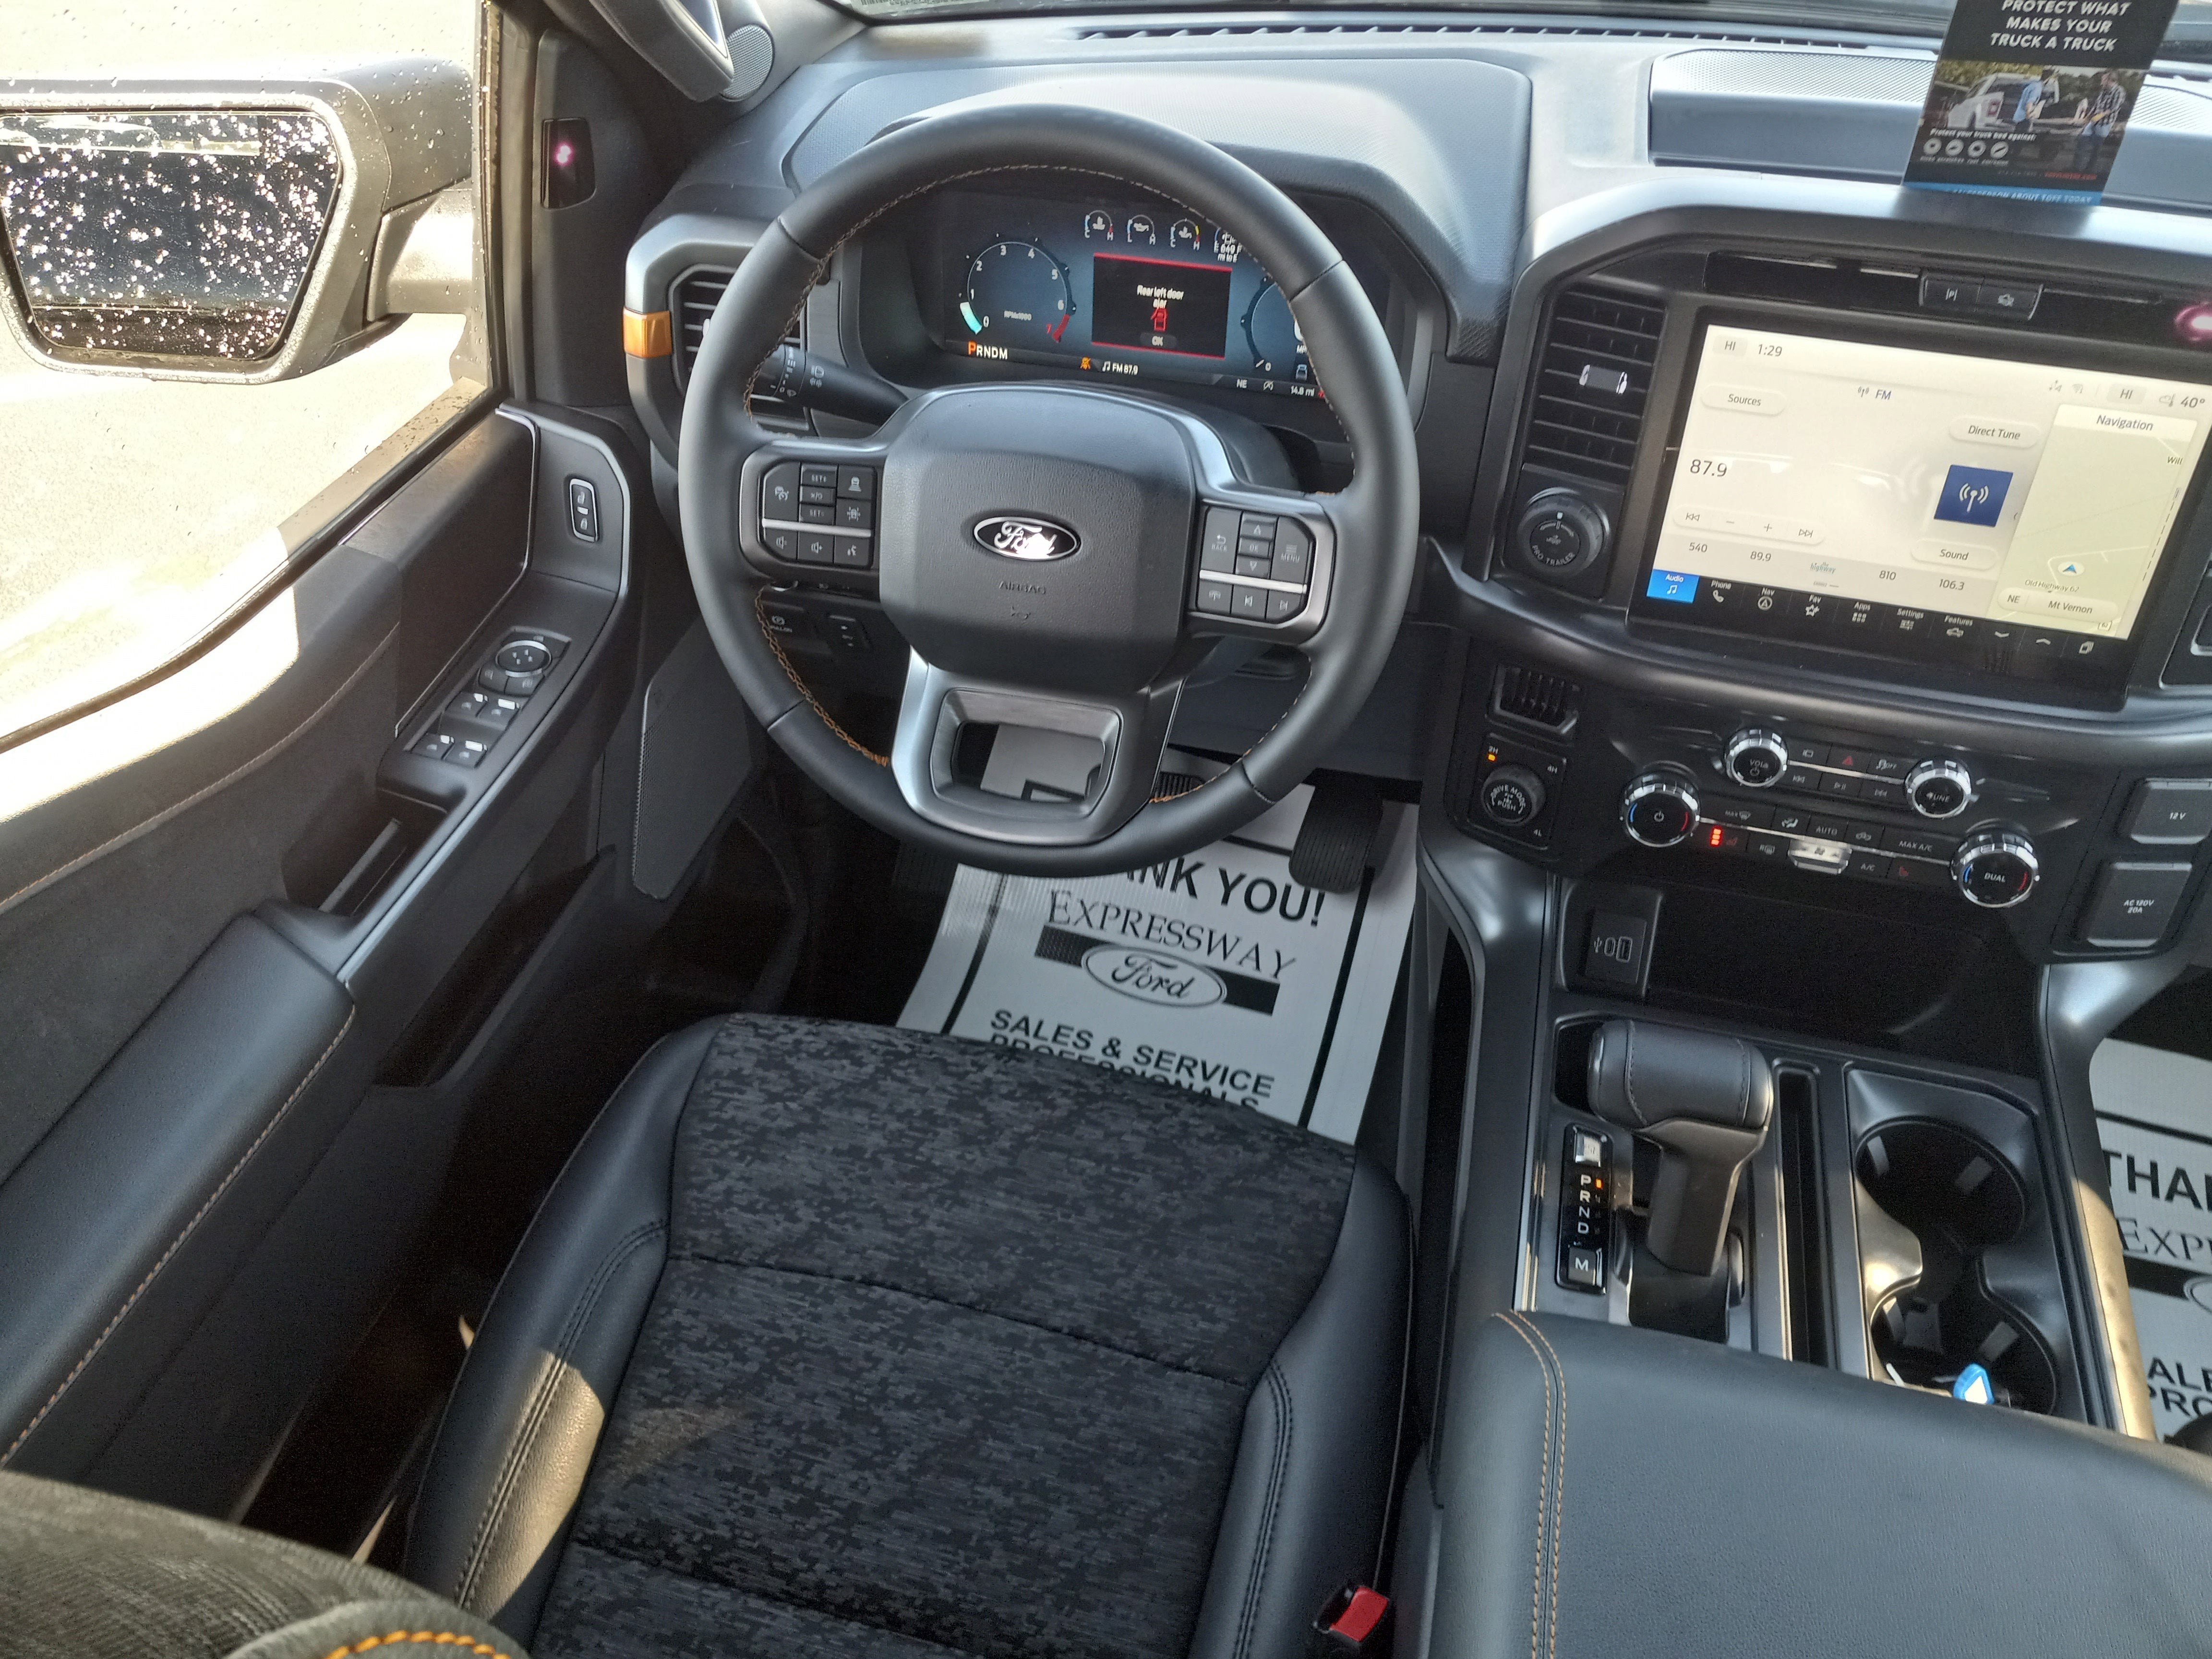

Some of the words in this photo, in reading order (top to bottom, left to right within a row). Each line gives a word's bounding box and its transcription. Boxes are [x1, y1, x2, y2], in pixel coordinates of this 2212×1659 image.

[2001, 0, 2078, 13] PROTECT
[2080, 1, 2132, 16] WHAT
[2006, 16, 2062, 32] MAKES
[2067, 18, 2113, 34] YOUR
[1990, 32, 2044, 48] TRUCK
[2044, 36, 2057, 49] A
[2063, 36, 2118, 52] TRUCK
[1000, 245, 1007, 255] 3
[1028, 248, 1035, 259] 4
[976, 261, 982, 271] 2
[1051, 269, 1058, 280] 5
[971, 289, 974, 300] 1
[1137, 285, 1154, 297] Rear
[1154, 287, 1166, 299] left
[1166, 288, 1185, 300] door
[1058, 300, 1064, 310] 6
[983, 315, 990, 327] 0
[1152, 336, 1164, 346] OK
[1724, 340, 1736, 351] HI
[1757, 343, 1782, 357] 1:29
[1112, 362, 1123, 374] FM
[1124, 364, 1139, 375] 87.9
[1265, 362, 1272, 372] 0
[1236, 379, 1248, 388] NE
[1728, 394, 1761, 407] Sources
[1875, 389, 1892, 400] FM
[2119, 389, 2133, 400] HI
[2096, 414, 2153, 432] Navigation
[1968, 425, 1995, 437] Direct
[1997, 429, 2021, 440] Tune
[1689, 459, 1728, 477] 87.9
[994, 520, 1058, 555] Fod
[1688, 542, 1708, 553] 540
[1281, 553, 1300, 564] MENU
[1750, 551, 1772, 562] 89.9
[1939, 549, 1970, 561] Sound
[1665, 574, 1684, 583] Audio
[1879, 570, 1897, 581] 810
[1711, 580, 1732, 590] Phone
[1938, 578, 1965, 591] 106.3
[2038, 581, 2068, 592] Highway
[1761, 587, 1776, 596] Nav
[1809, 594, 1822, 604] Fav
[2007, 594, 2020, 604] NE
[1854, 601, 1871, 612] Apps
[2048, 600, 2060, 610] Mt
[2063, 602, 2093, 614] Vernon
[1897, 608, 1924, 620] Settings
[1944, 615, 1973, 627] Features
[1899, 840, 1917, 849] MAX
[1984, 872, 2006, 883] DUAL
[1218, 867, 1326, 927] YOU!
[1048, 889, 1297, 979] EXPRESSWAY
[1111, 953, 1195, 999] Ford
[990, 1009, 1094, 1051] SALES
[1101, 1036, 1122, 1060] &
[1132, 1045, 1275, 1098] SERVICE
[1580, 1174, 1592, 1187] P
[1580, 1190, 1591, 1203] R
[1579, 1205, 1590, 1219] N
[1577, 1221, 1589, 1235] D
[2115, 1216, 2212, 1260] EXP
[1575, 1257, 1589, 1272] M
[2148, 1384, 2212, 1417] RO
